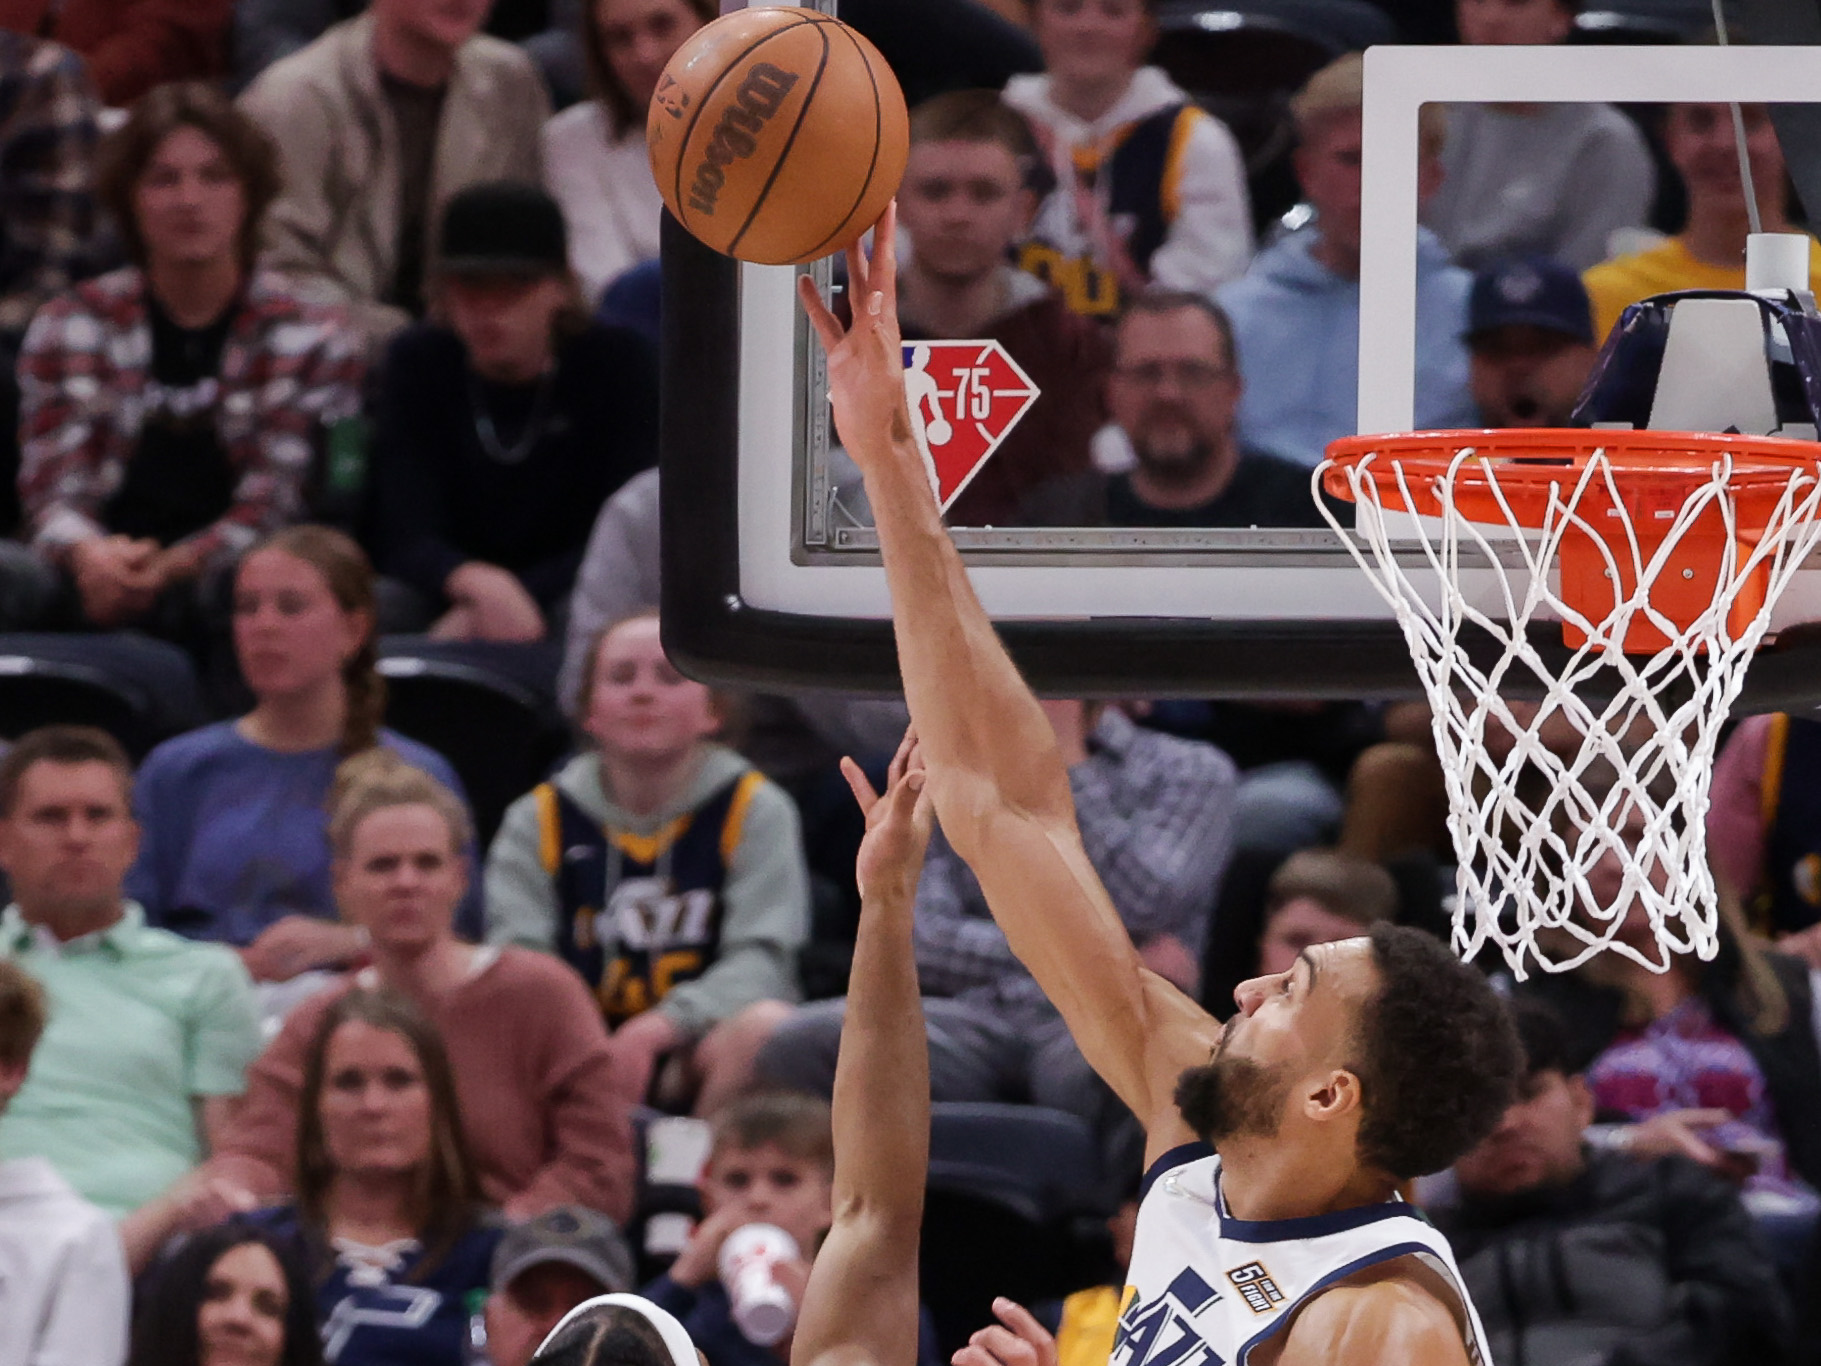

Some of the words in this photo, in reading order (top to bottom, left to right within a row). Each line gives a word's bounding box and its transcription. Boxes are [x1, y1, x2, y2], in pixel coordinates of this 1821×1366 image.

[689, 62, 800, 216] Wilson
[952, 367, 991, 420] 75
[1231, 1264, 1265, 1283] 5
[1240, 1284, 1271, 1311] FIGHT
